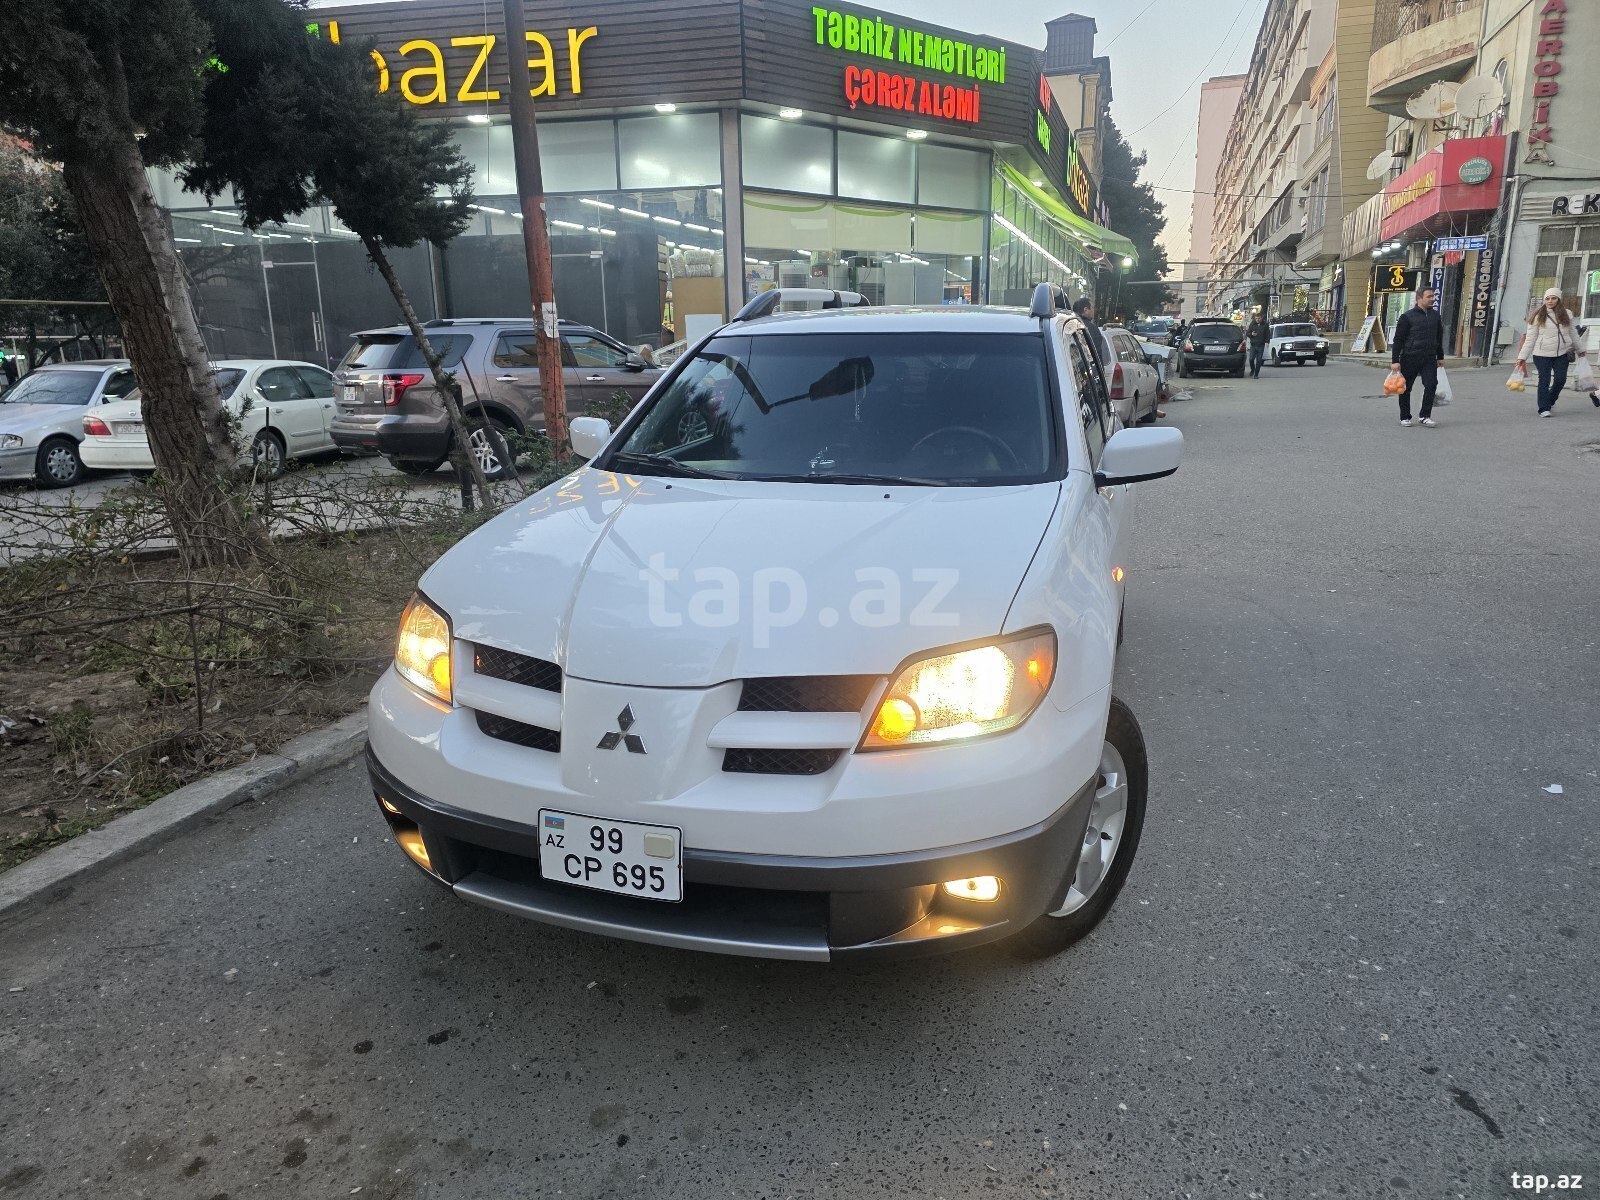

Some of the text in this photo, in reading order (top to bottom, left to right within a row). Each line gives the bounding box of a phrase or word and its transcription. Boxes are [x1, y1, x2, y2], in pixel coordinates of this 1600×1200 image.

[812, 7, 1006, 83] TƏBRİZ NEMƏTLƏRİ
[845, 65, 980, 123] ÇƏRƏZ ALƏMİ
[545, 833, 565, 848] AZ
[590, 825, 623, 854] 99
[564, 853, 665, 892] CP 695
